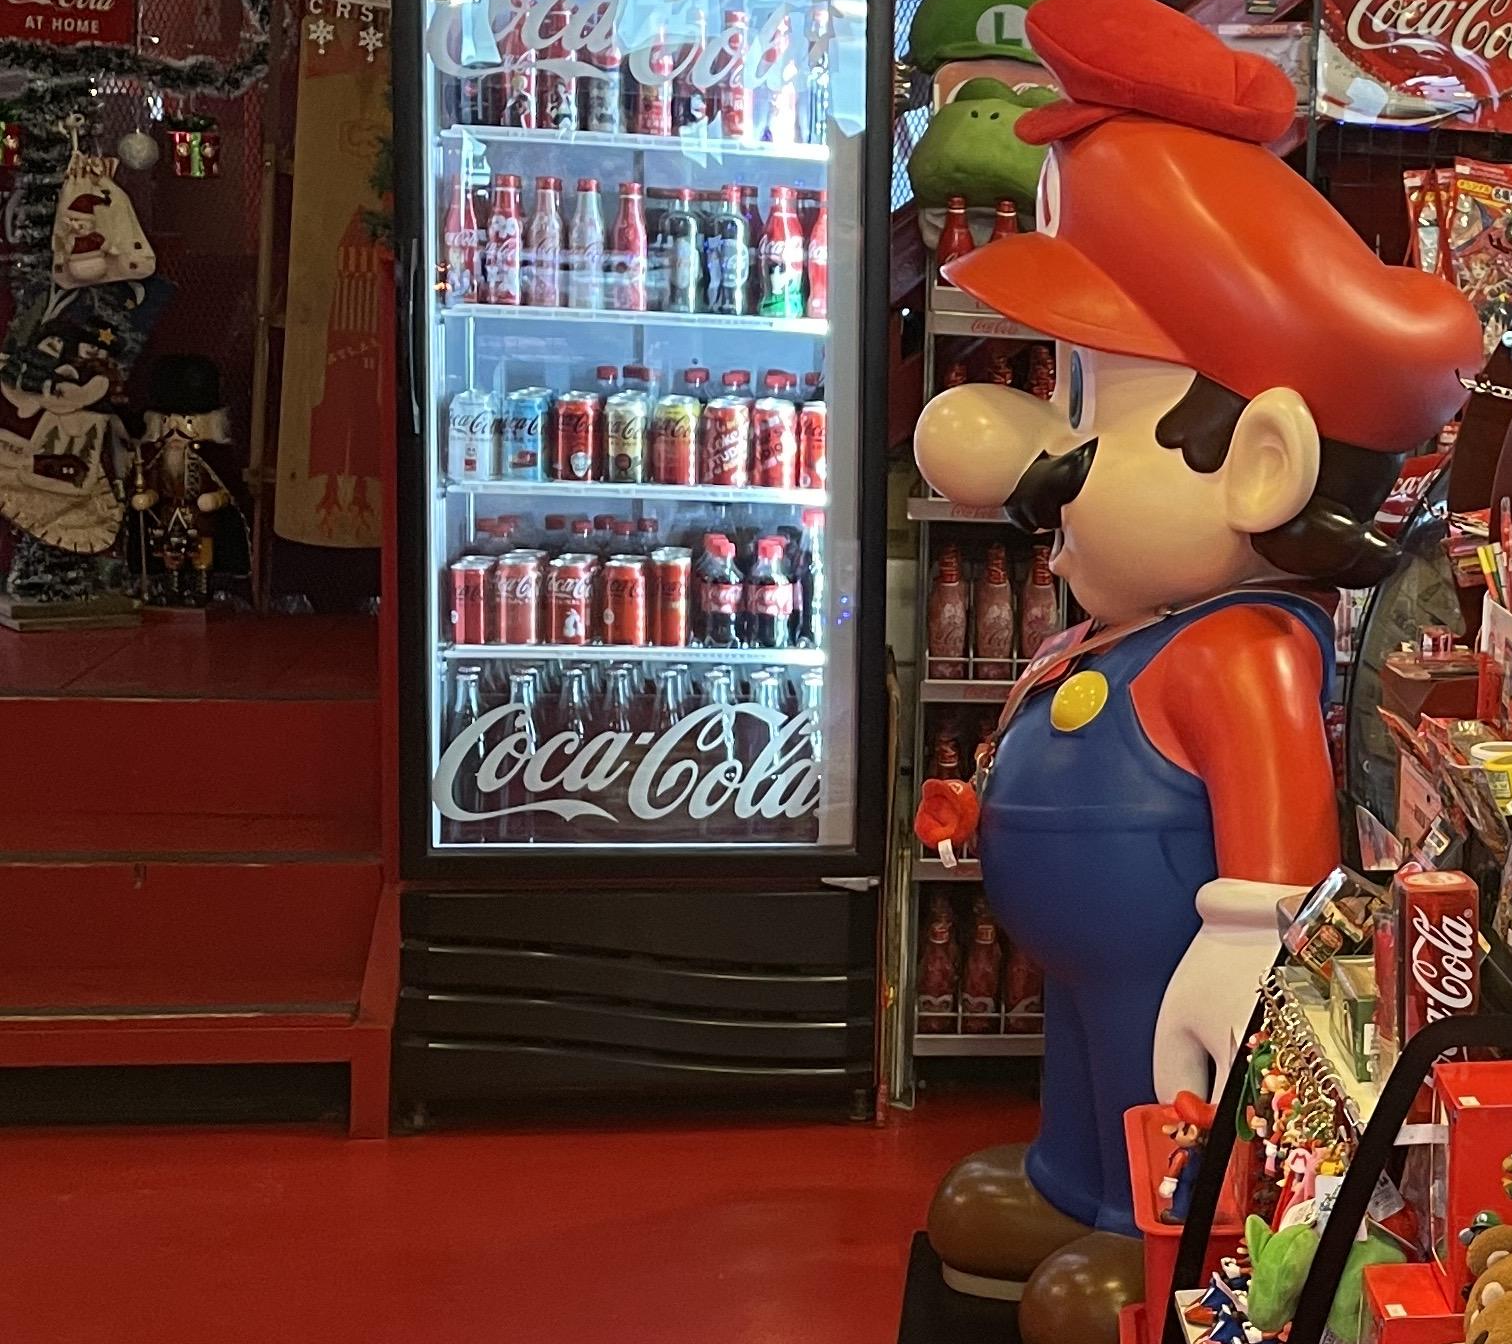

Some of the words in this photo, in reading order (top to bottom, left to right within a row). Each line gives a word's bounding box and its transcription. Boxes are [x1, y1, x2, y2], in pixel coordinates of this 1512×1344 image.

[24, 15, 48, 30] AT
[52, 15, 101, 34] HOME
[994, 11, 1023, 46] L
[432, 703, 823, 823] Coca-Cola
